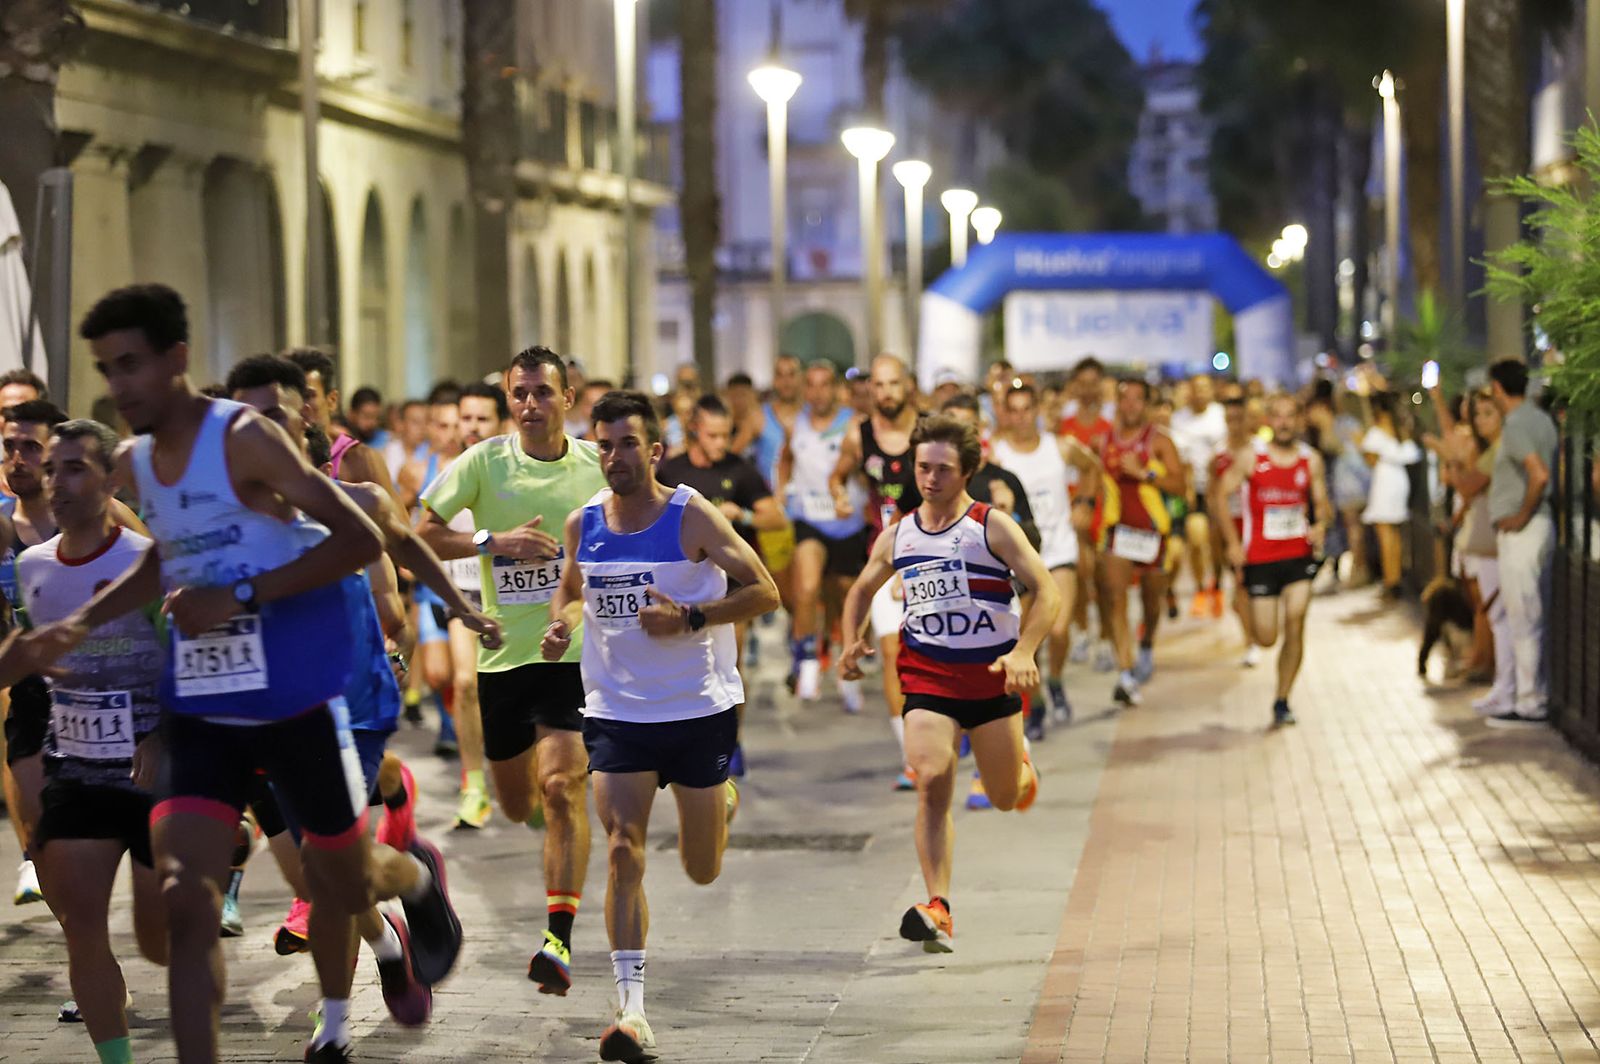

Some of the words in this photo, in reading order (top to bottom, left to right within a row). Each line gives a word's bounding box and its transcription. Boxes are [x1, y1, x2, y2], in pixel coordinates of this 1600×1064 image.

[514, 568, 548, 589] 675
[918, 578, 947, 599] 303
[606, 593, 639, 615] 578
[194, 645, 235, 673] 751
[71, 715, 102, 741] 111
